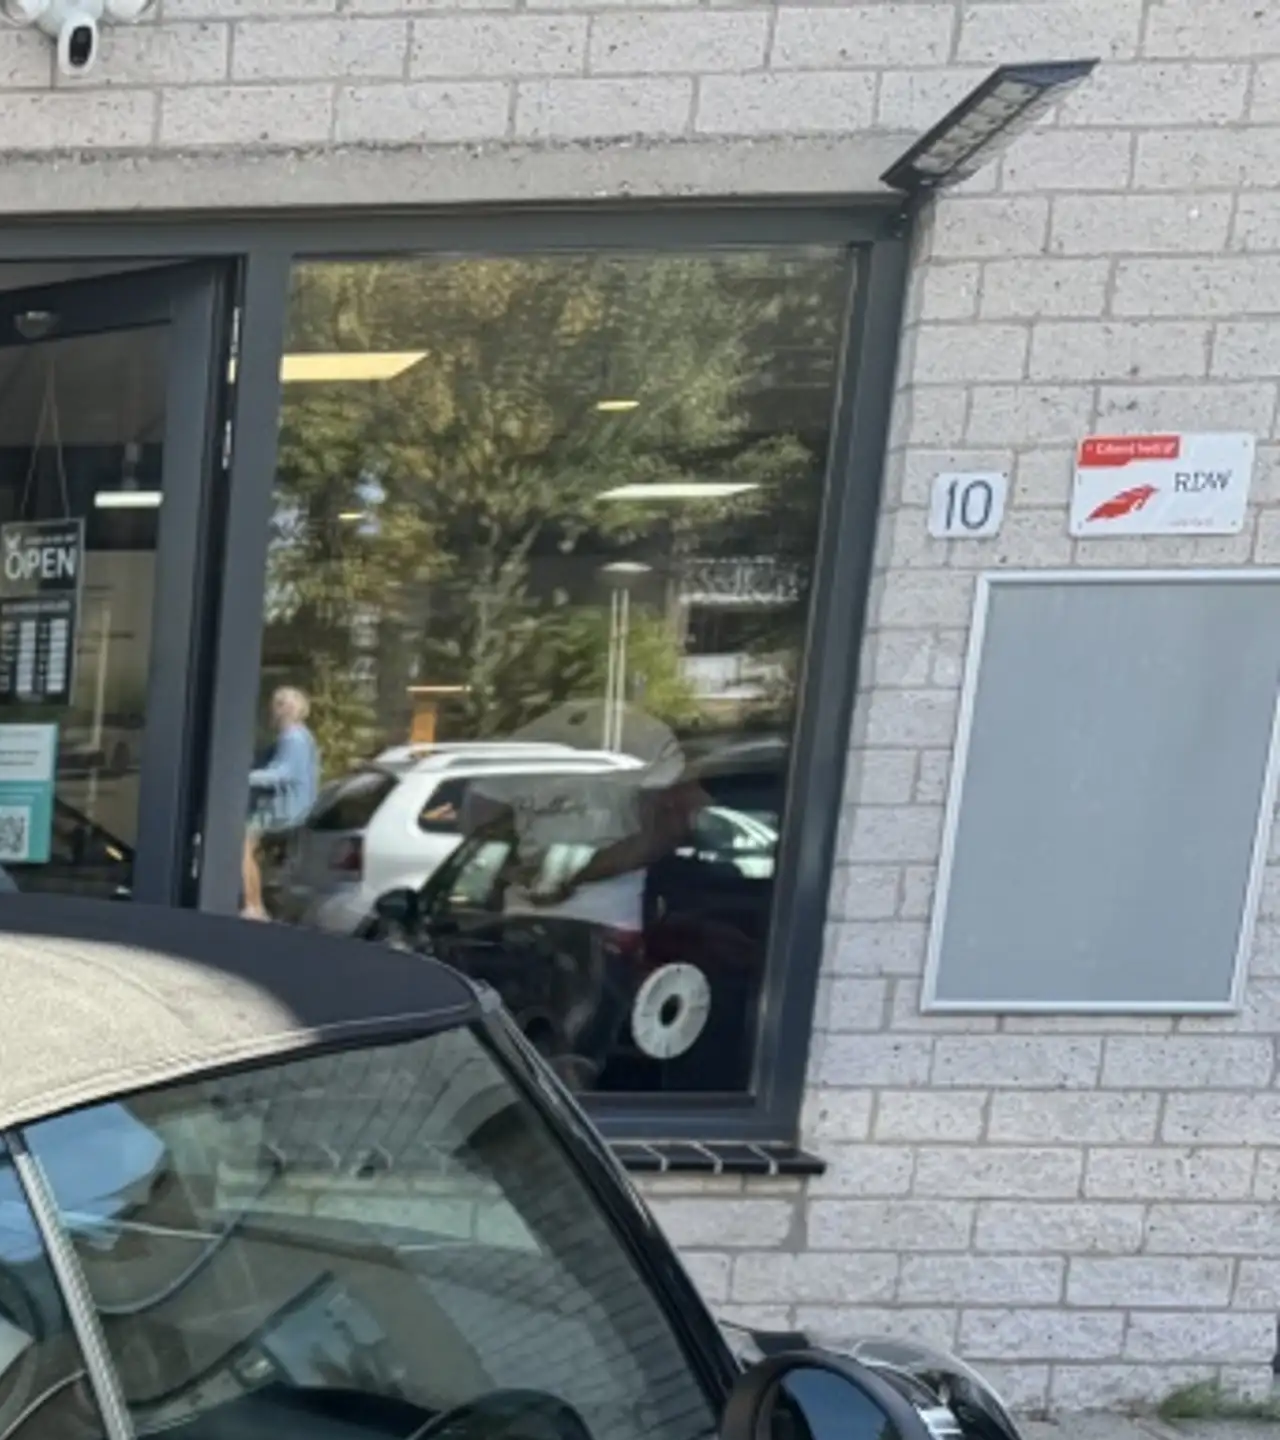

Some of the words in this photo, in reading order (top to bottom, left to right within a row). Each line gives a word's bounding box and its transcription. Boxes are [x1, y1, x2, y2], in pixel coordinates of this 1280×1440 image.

[1174, 470, 1233, 492] RDW
[945, 478, 993, 531] 10
[3, 546, 77, 581] OPEN
